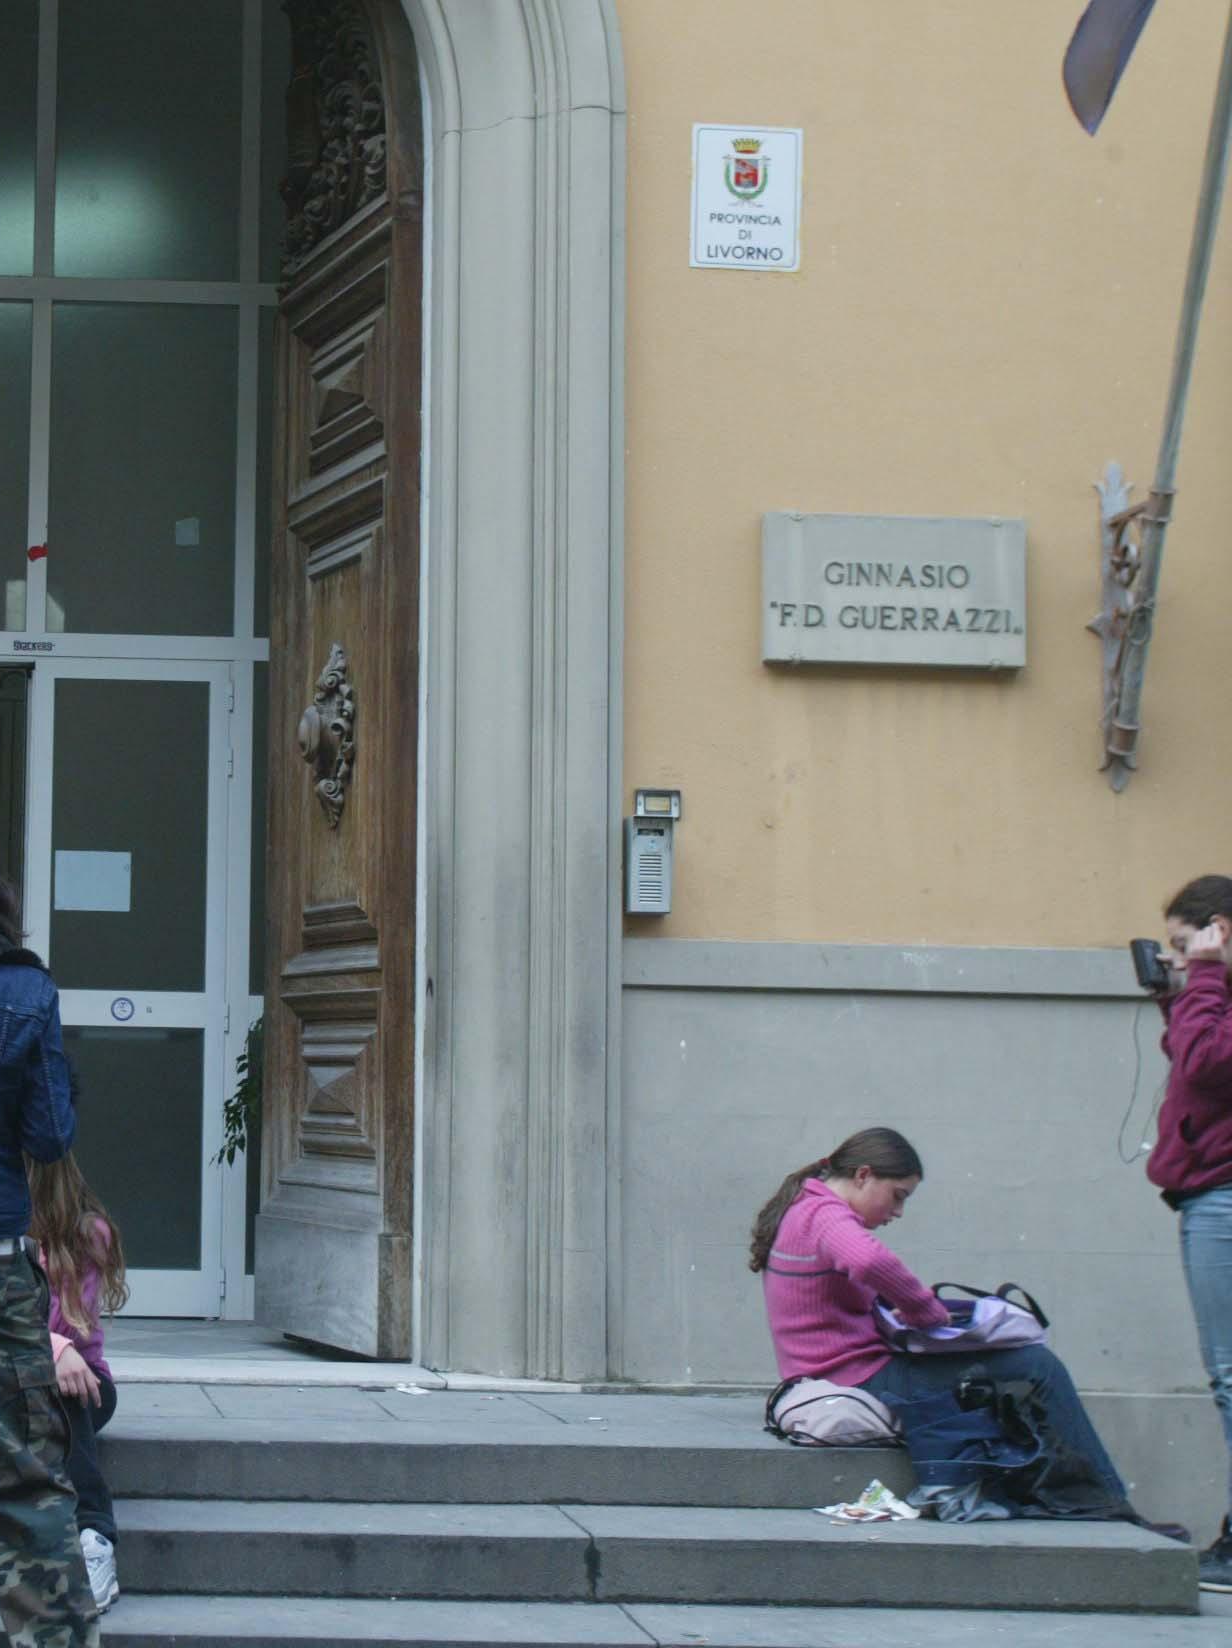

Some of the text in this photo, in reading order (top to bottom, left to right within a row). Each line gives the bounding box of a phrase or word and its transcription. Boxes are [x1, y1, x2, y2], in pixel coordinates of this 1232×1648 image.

[709, 212, 782, 226] PROVINCIA
[737, 229, 752, 240] DI
[706, 245, 784, 261] LIVORNO
[824, 561, 970, 589] GINNASIO
